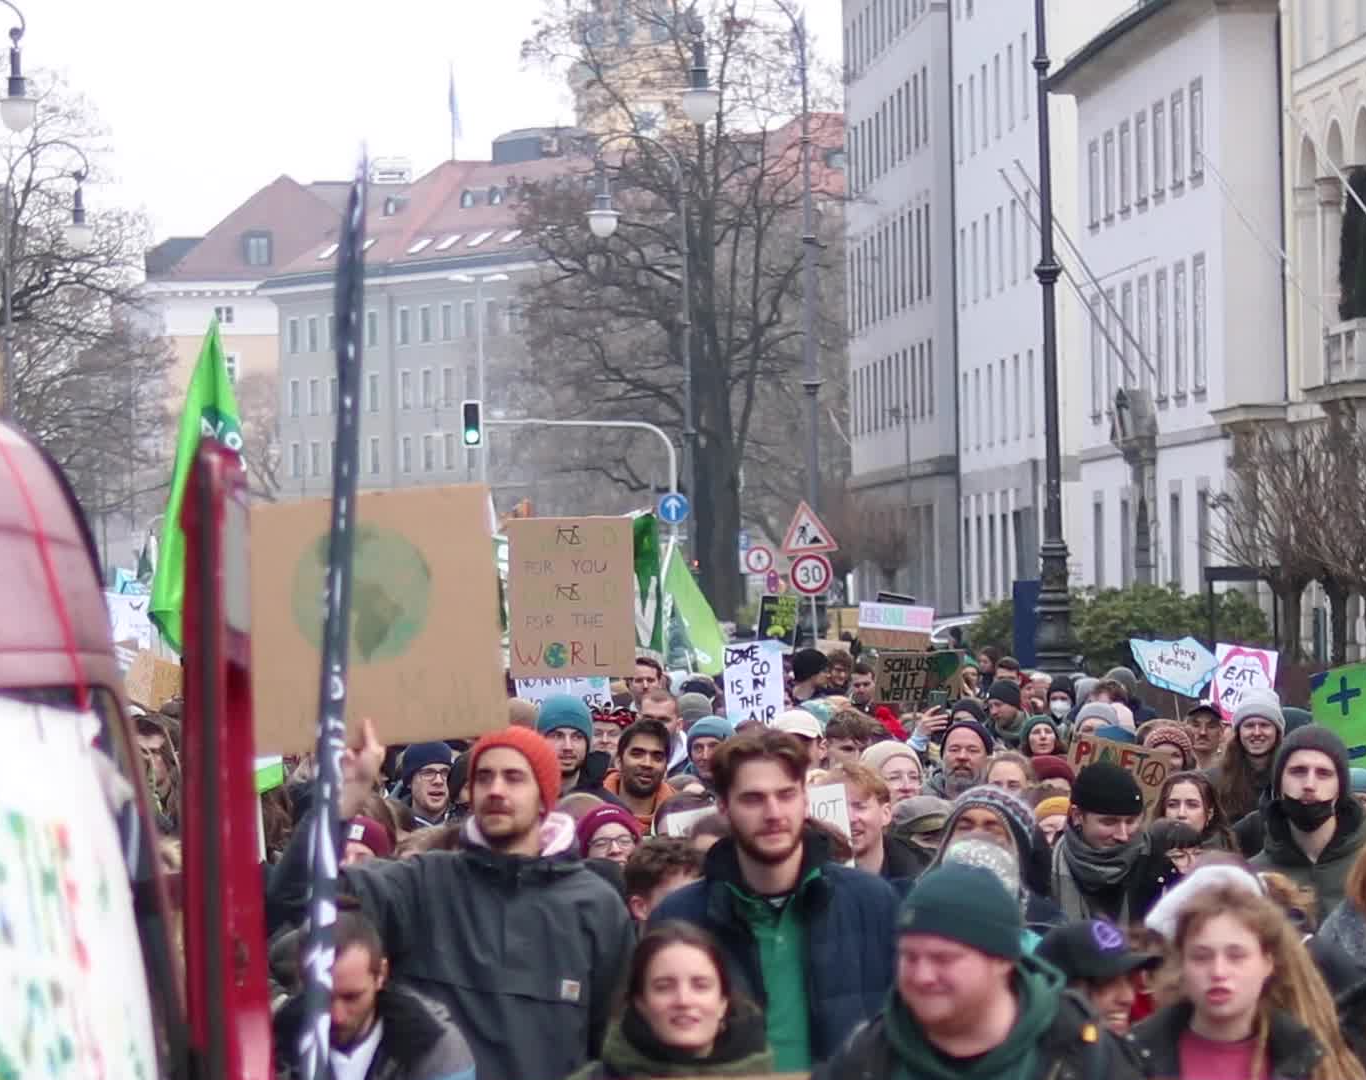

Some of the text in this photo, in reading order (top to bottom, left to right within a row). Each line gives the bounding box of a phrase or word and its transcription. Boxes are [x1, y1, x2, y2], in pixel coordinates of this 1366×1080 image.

[571, 560, 607, 574] YOU
[800, 565, 823, 584] 30
[571, 613, 604, 628] THE
[890, 673, 919, 688] MIT
[1223, 665, 1260, 686] EAT
[730, 678, 767, 695] IS IN
[739, 694, 763, 709] THE
[1221, 687, 1244, 706] RI
[749, 705, 776, 724] AIR
